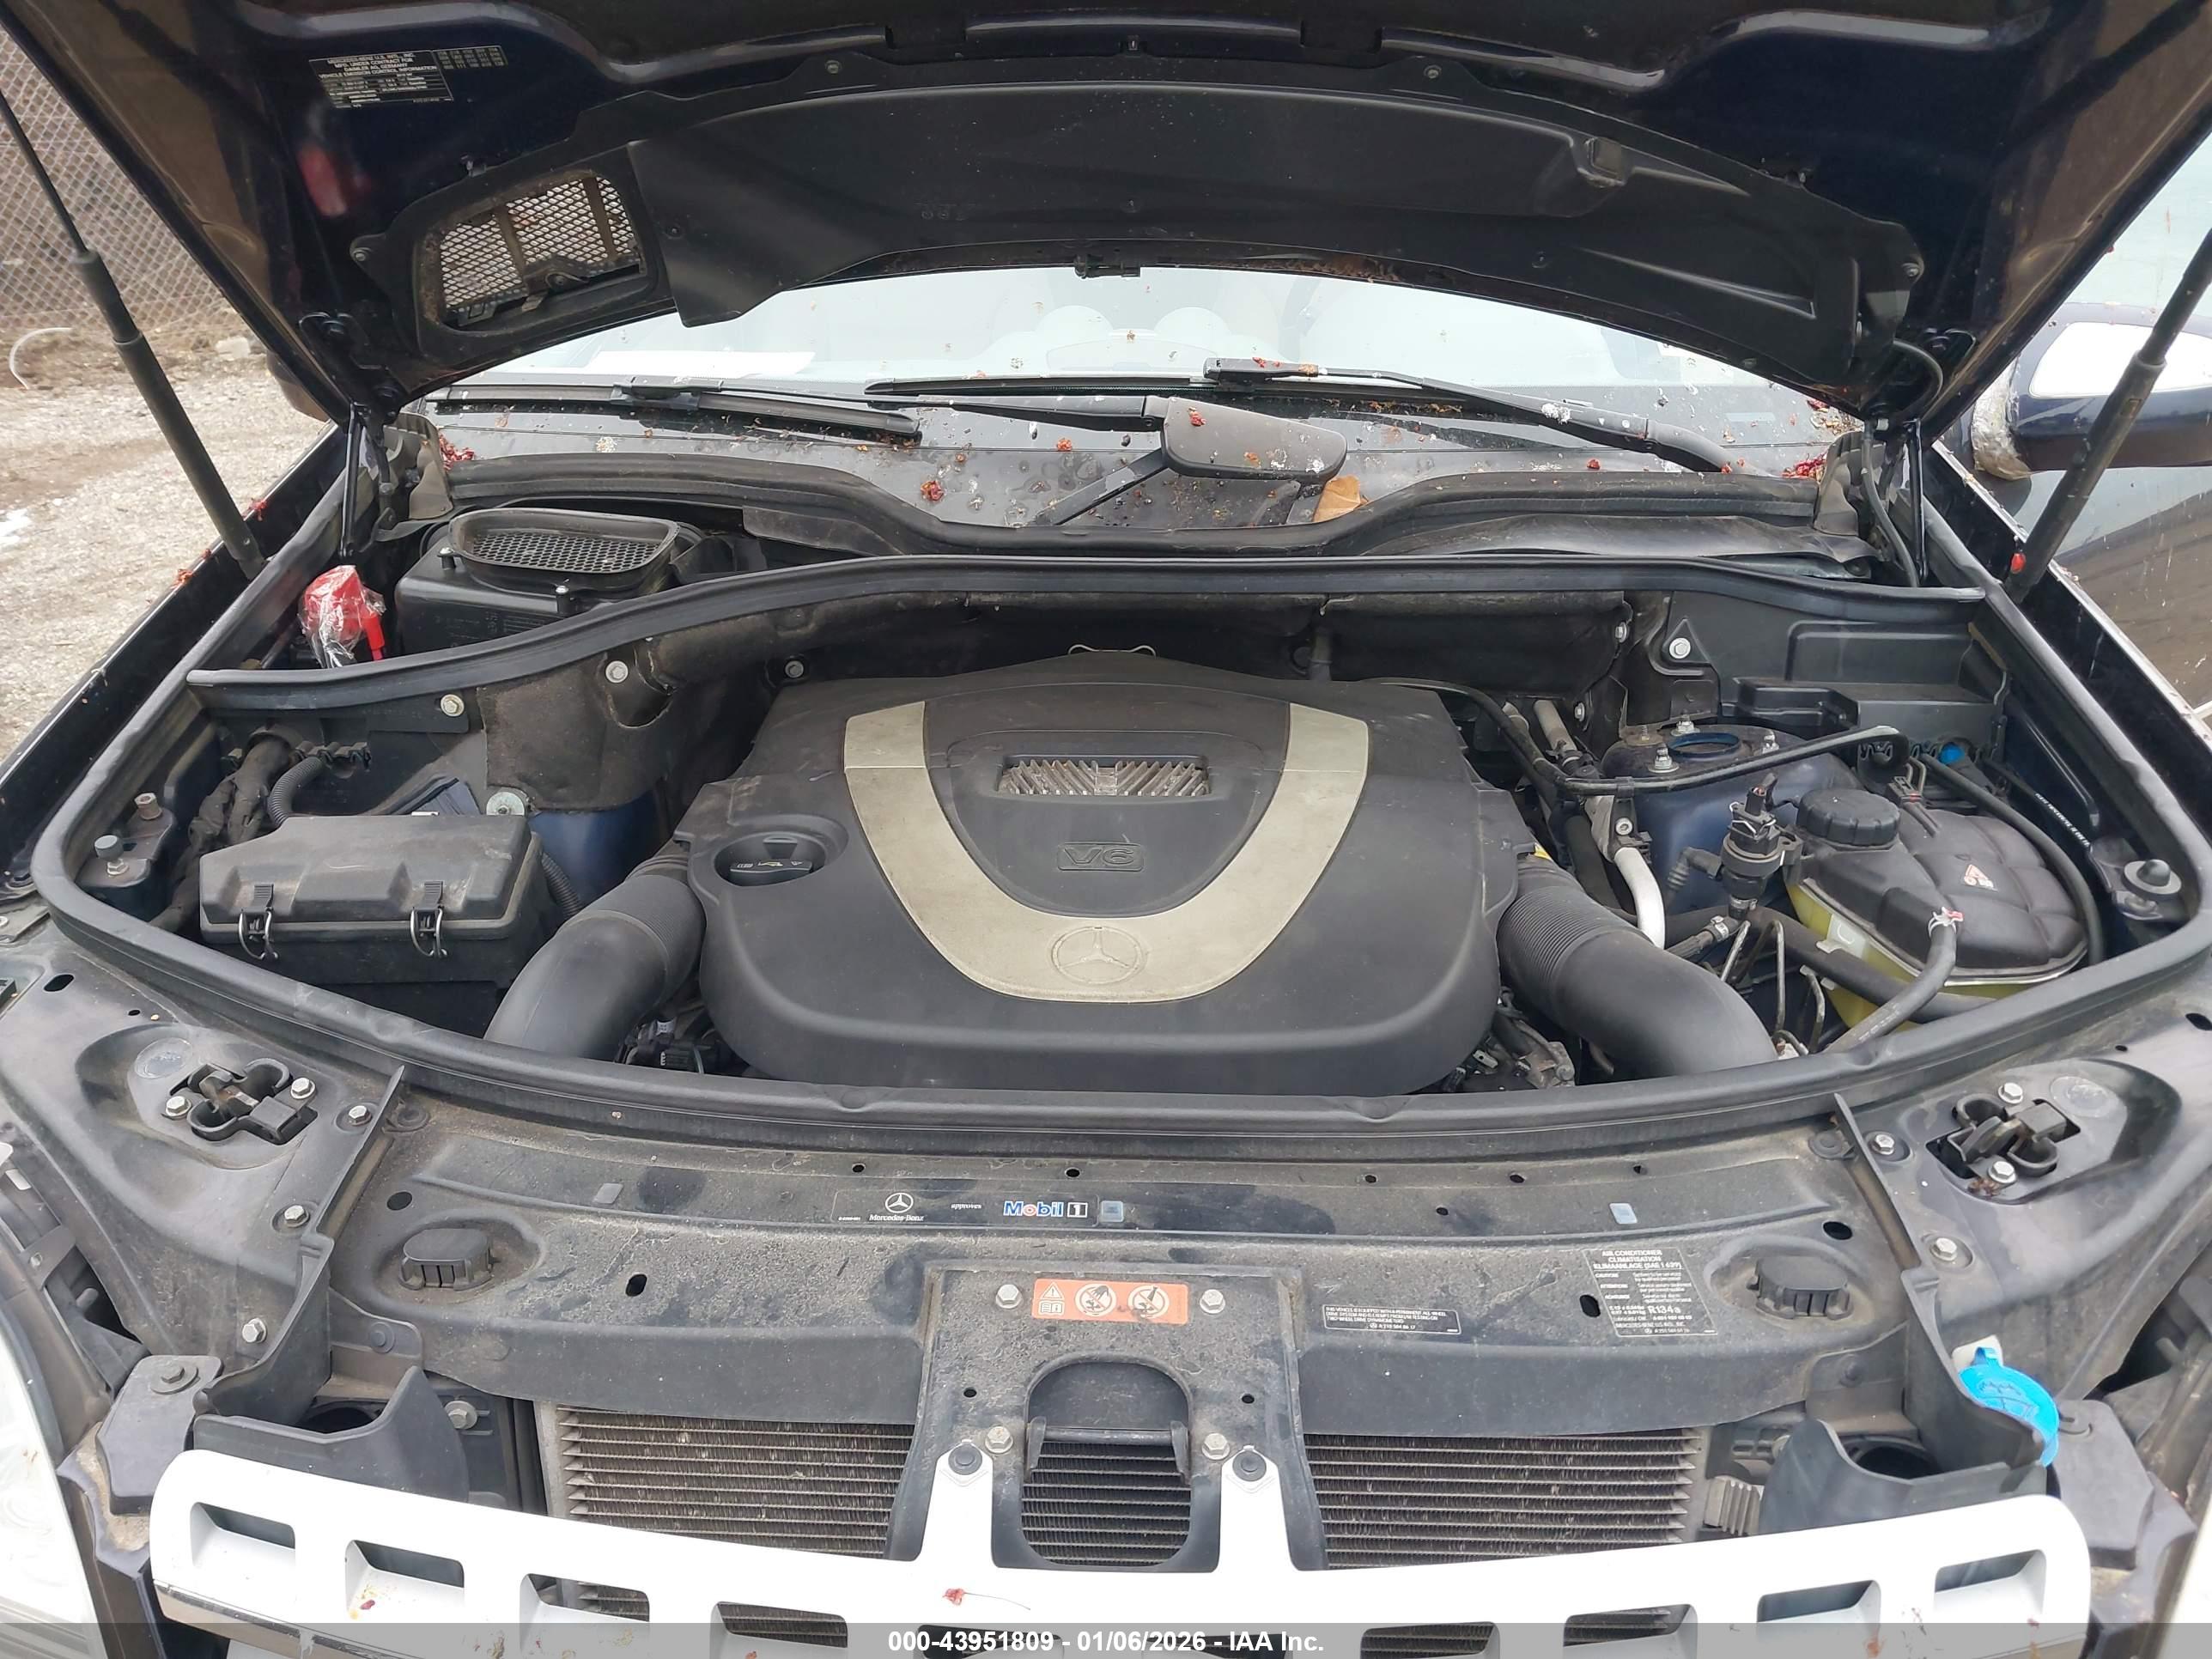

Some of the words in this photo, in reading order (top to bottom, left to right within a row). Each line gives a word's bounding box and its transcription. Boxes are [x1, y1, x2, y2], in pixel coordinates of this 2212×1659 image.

[1064, 846, 1135, 866] V6
[1003, 1200, 1064, 1218] Mobil
[1647, 1305, 1681, 1314] R134a
